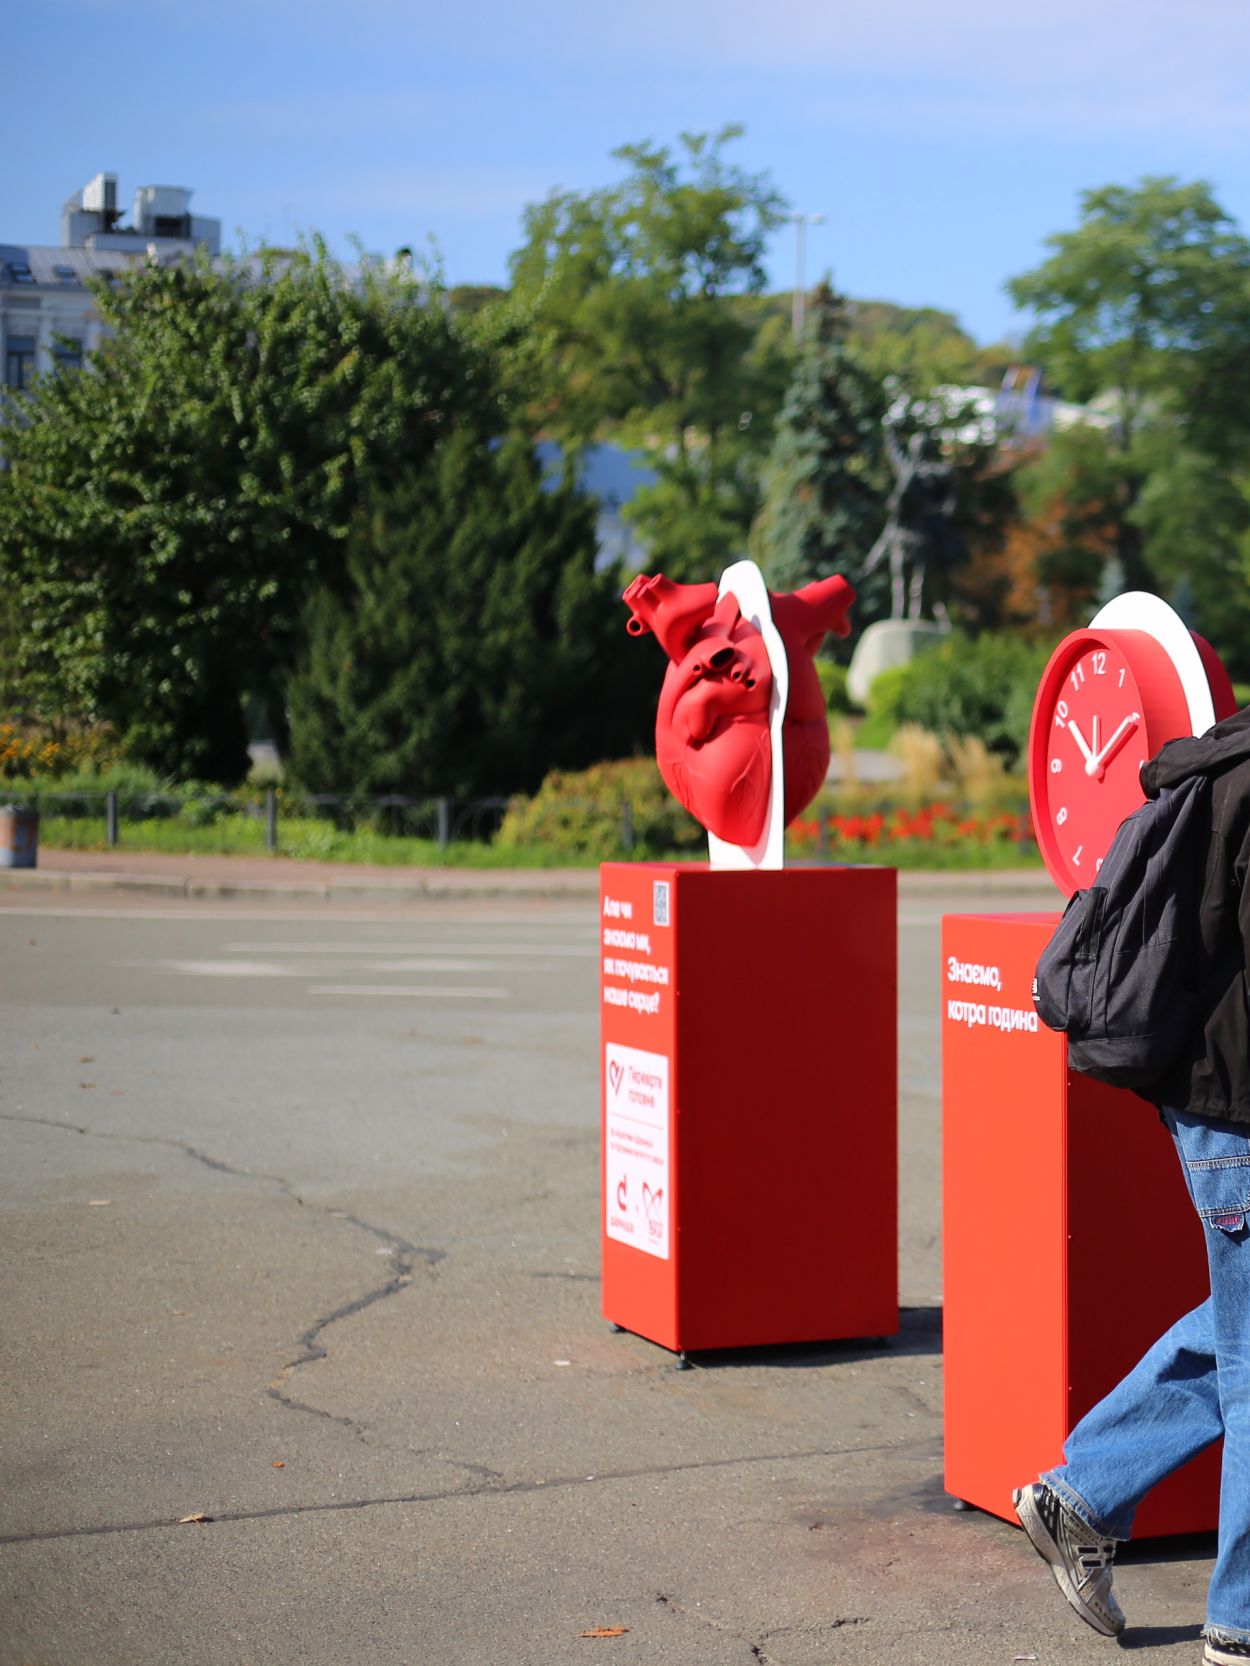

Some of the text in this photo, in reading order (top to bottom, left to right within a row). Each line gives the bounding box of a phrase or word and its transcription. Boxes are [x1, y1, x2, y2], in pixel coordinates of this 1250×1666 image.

[1070, 662, 1085, 691] 11
[1091, 652, 1106, 675] 12
[1118, 668, 1126, 688] 1
[1055, 700, 1068, 728] 10
[1056, 807, 1067, 826] 8
[947, 956, 1002, 992] Знаємо,
[947, 1000, 1038, 1033] котра година
